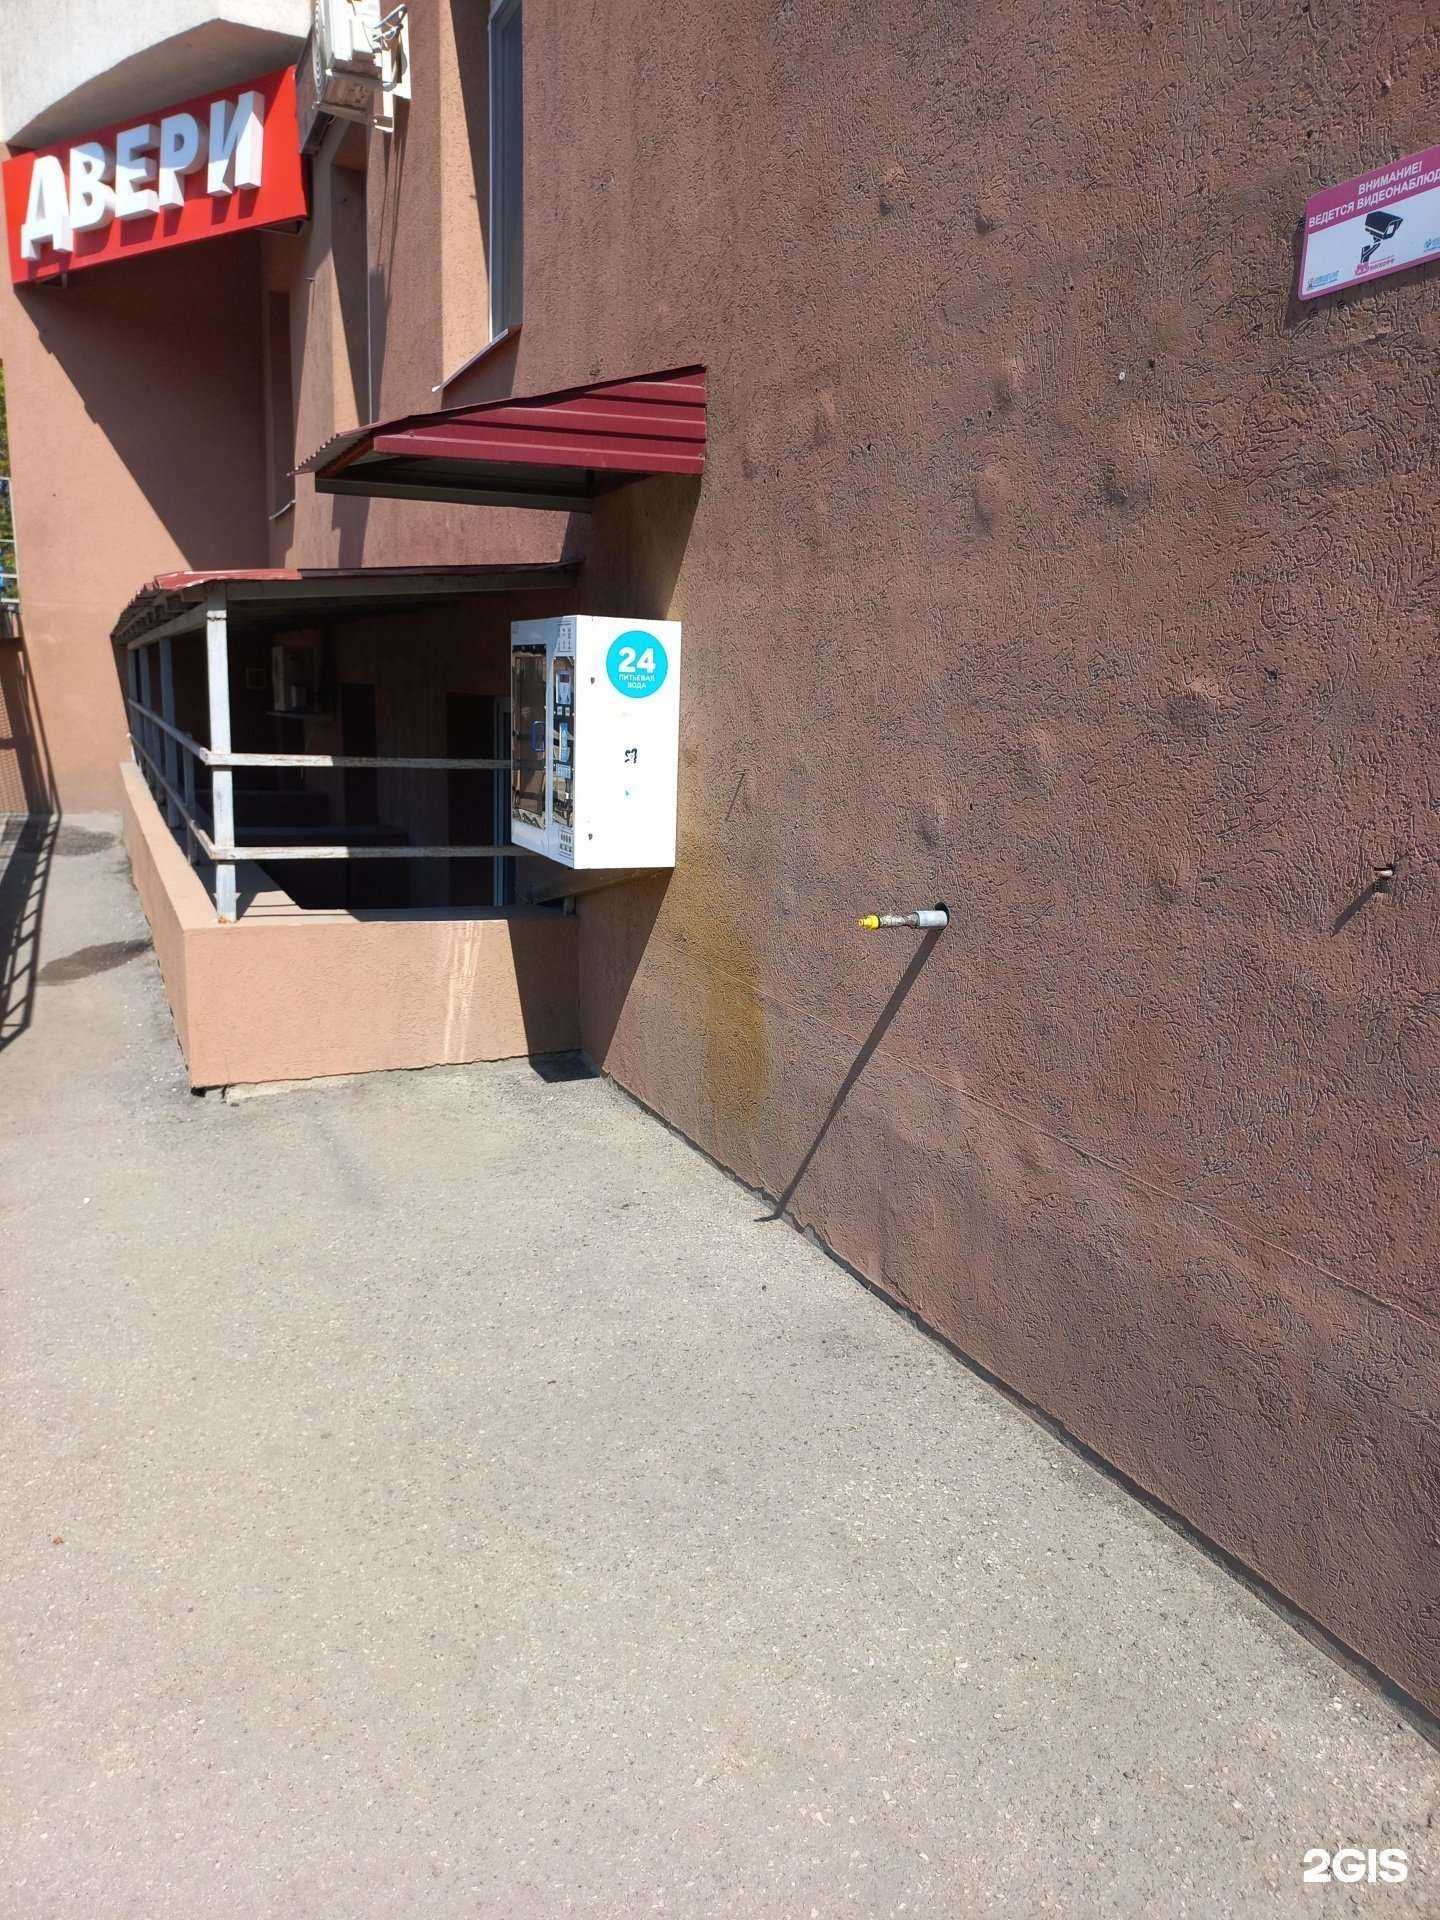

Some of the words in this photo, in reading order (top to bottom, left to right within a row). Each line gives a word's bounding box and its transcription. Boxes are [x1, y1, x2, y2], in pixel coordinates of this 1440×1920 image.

[21, 90, 265, 260] ДВЕРИ
[1358, 160, 1423, 195] ВНИМАНИЕ!
[1309, 202, 1355, 228] ВЕДЕТСЯ
[618, 646, 656, 674] 24
[627, 681, 647, 690] ВОДА
